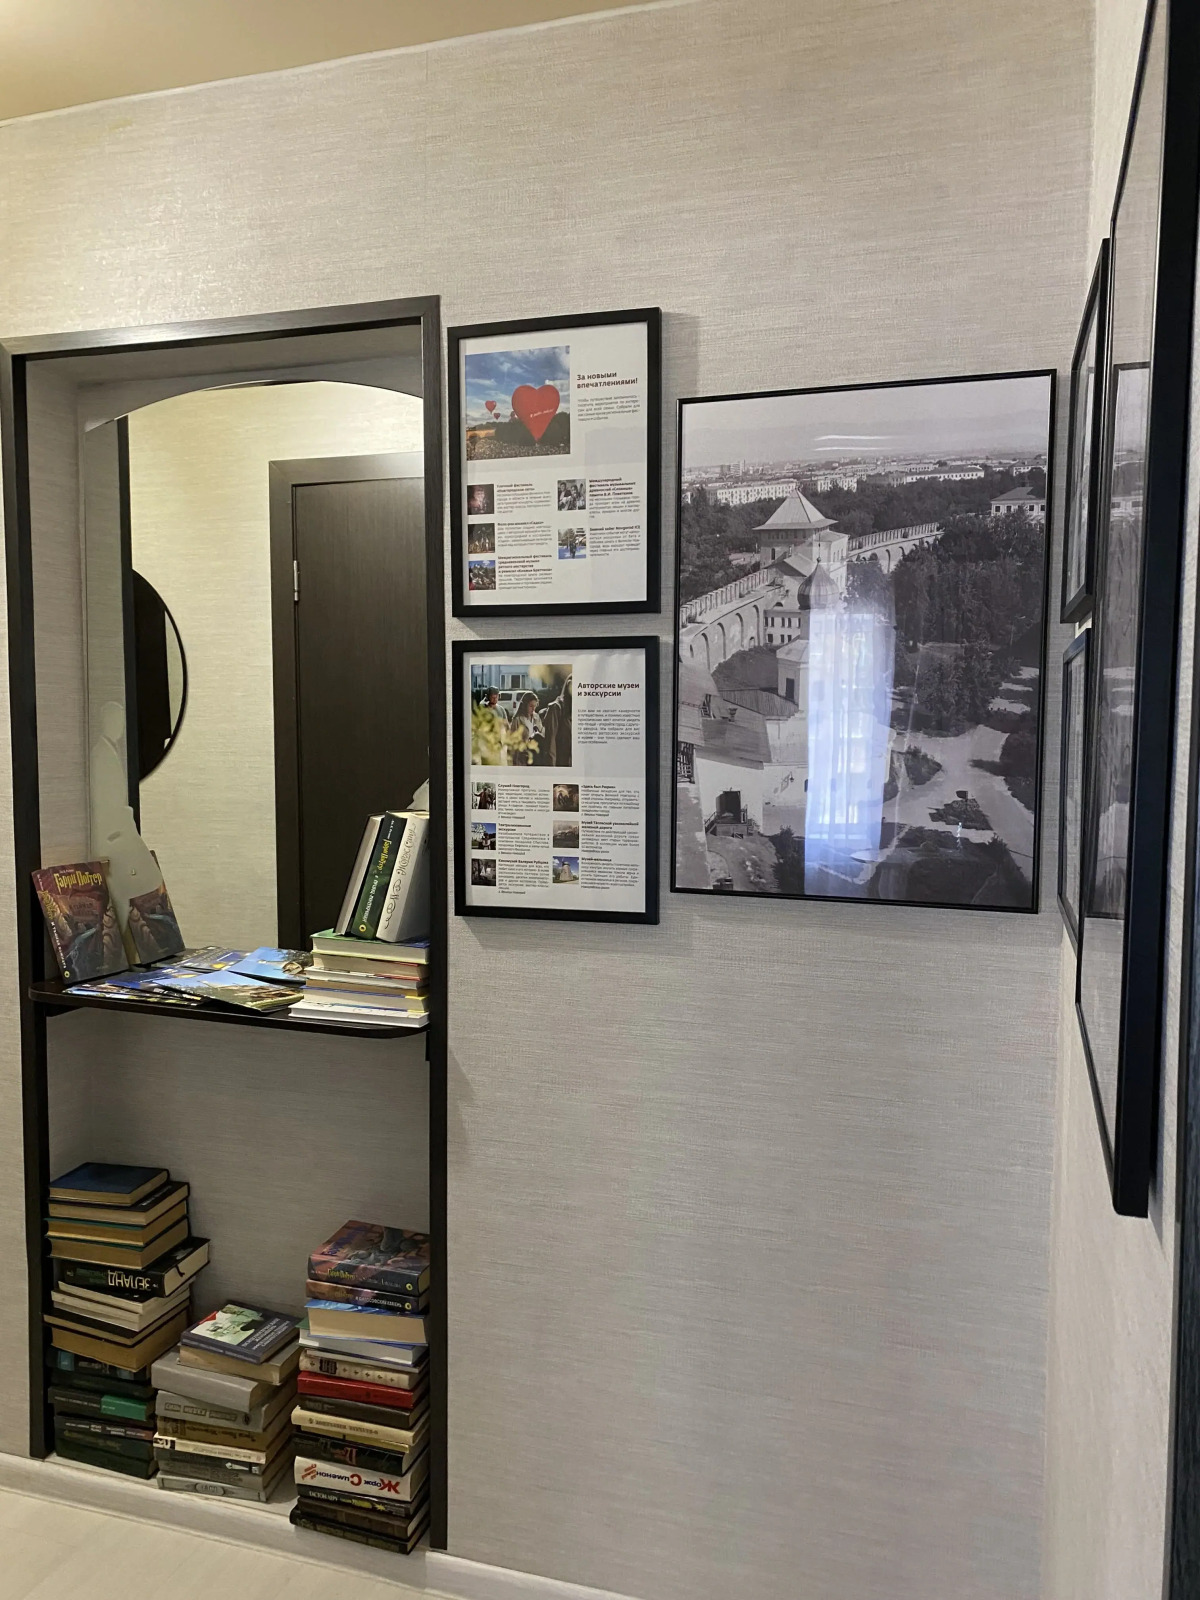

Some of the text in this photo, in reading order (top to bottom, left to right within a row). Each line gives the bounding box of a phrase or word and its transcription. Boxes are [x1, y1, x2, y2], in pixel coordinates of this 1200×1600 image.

[576, 377, 638, 389] впечатлениями!
[587, 372, 617, 380] новыми
[577, 682, 640, 691] Авторские музеи
[53, 872, 77, 894] Гарри
[76, 870, 103, 886] Поттер
[107, 1270, 152, 1292] ЗЕЛАНД
[316, 1469, 362, 1487] Сименон
[363, 1477, 401, 1495] Жорж
